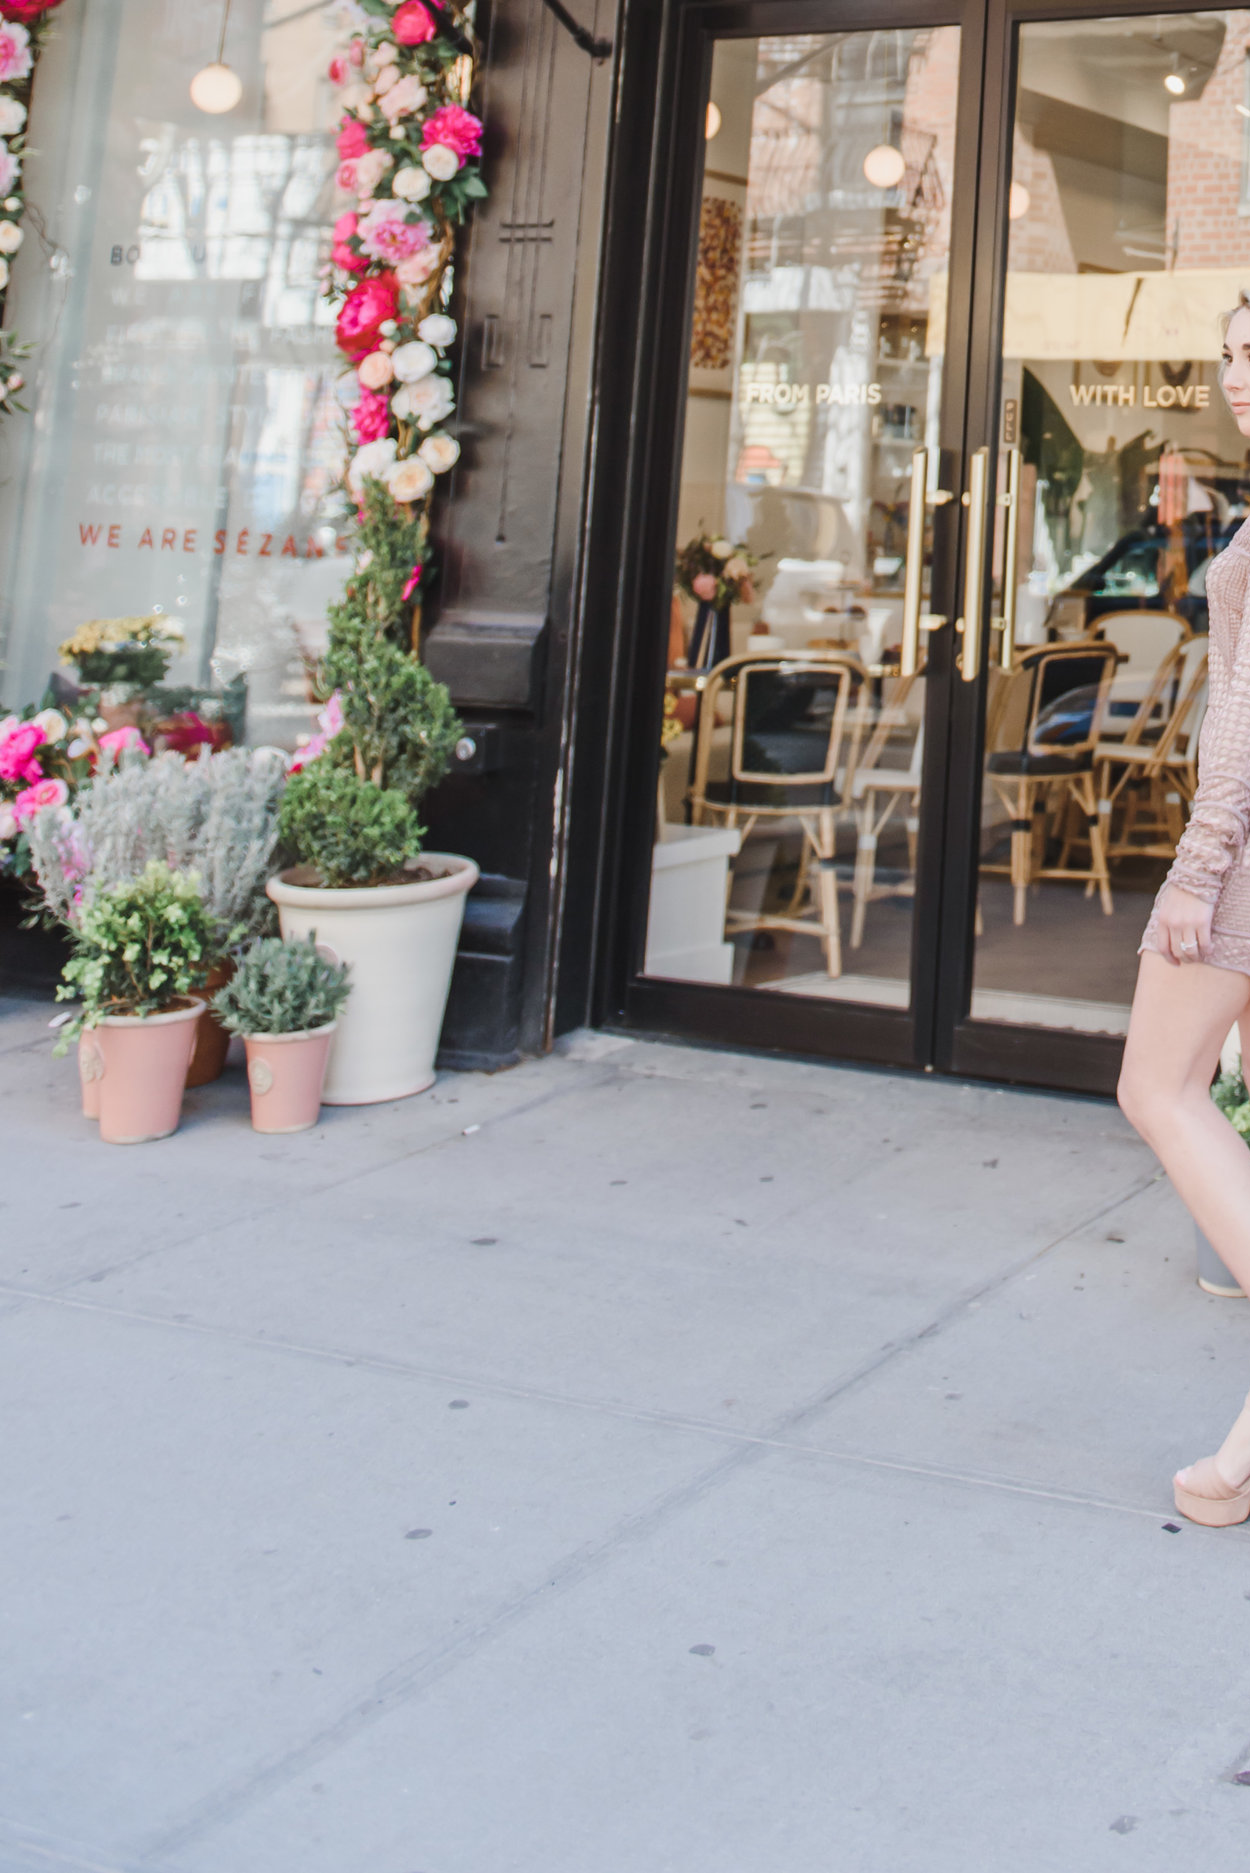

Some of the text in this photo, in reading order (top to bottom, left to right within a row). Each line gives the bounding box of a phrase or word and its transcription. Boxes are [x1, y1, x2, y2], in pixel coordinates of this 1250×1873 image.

[745, 382, 883, 405] FROM PARIS
[1070, 384, 1211, 409] WITH LOVE
[79, 523, 121, 548] WE
[137, 528, 197, 553] ARE
